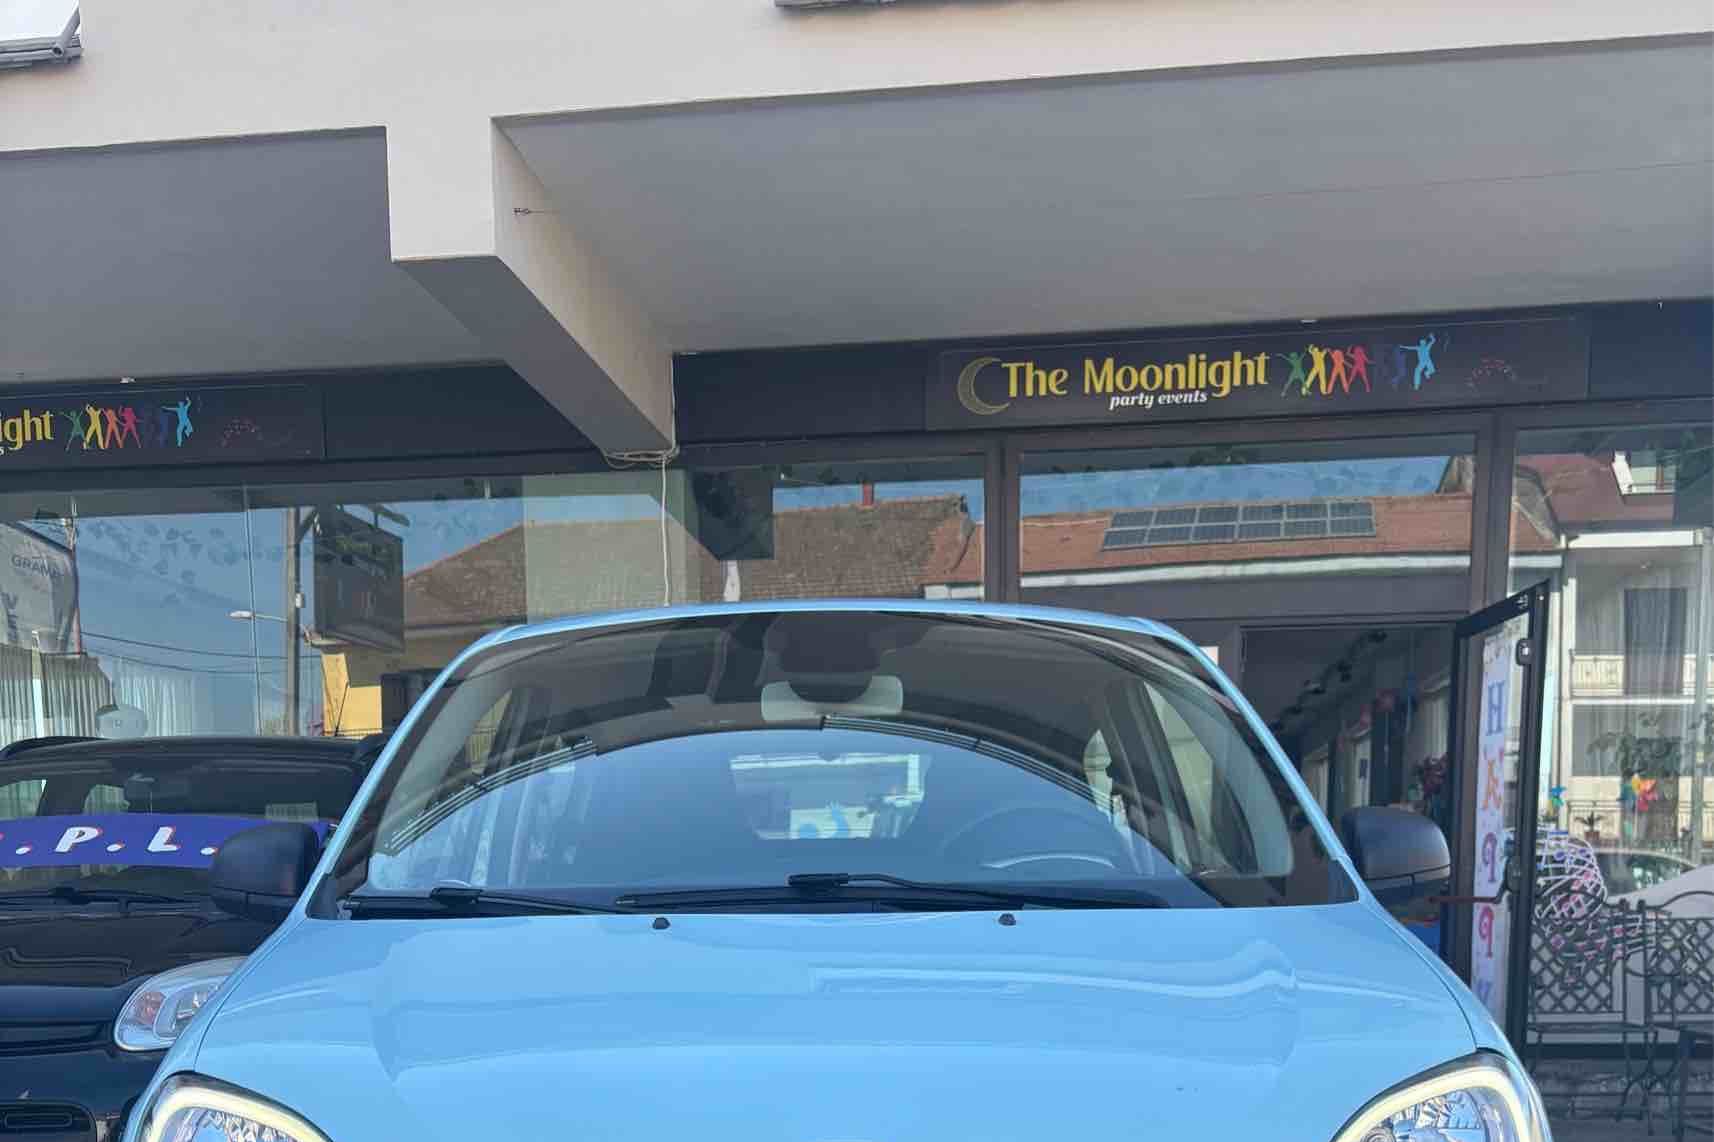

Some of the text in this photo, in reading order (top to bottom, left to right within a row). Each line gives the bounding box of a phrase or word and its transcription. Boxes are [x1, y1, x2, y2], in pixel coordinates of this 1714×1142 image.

[1002, 352, 1269, 397] The Moonlight
[1108, 389, 1208, 411] party events
